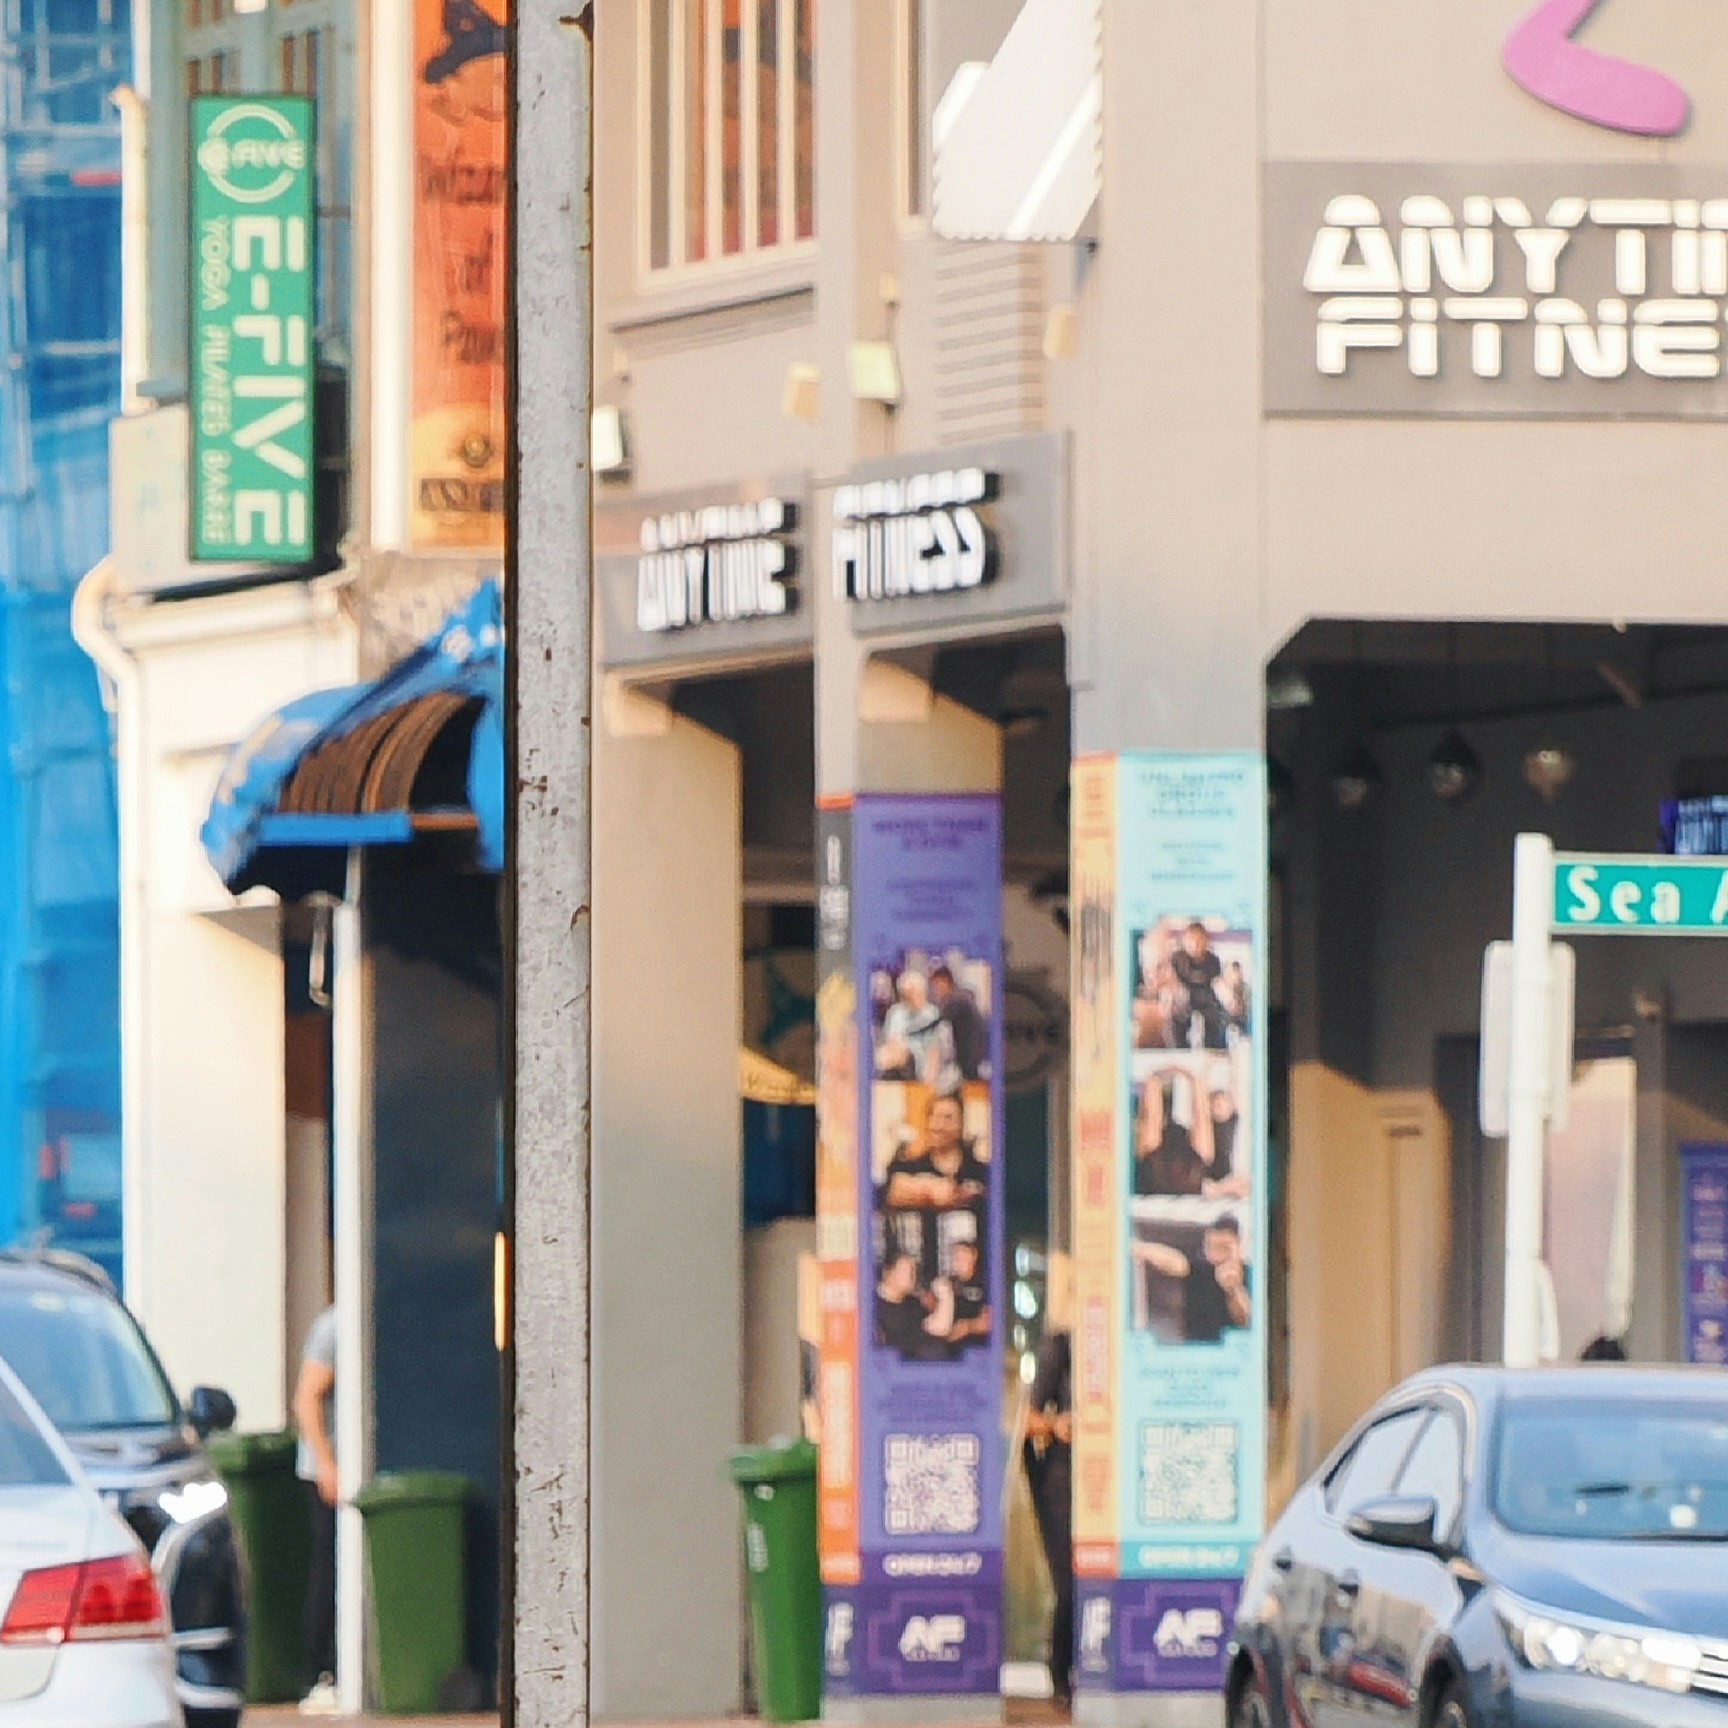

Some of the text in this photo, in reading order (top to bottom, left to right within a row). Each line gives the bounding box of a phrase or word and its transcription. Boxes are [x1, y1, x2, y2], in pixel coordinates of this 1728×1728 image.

[201, 214, 230, 311] YOGA
[231, 214, 306, 547] E-FIVE
[1316, 296, 1728, 379] FITNE
[1567, 865, 1681, 924] Sea
